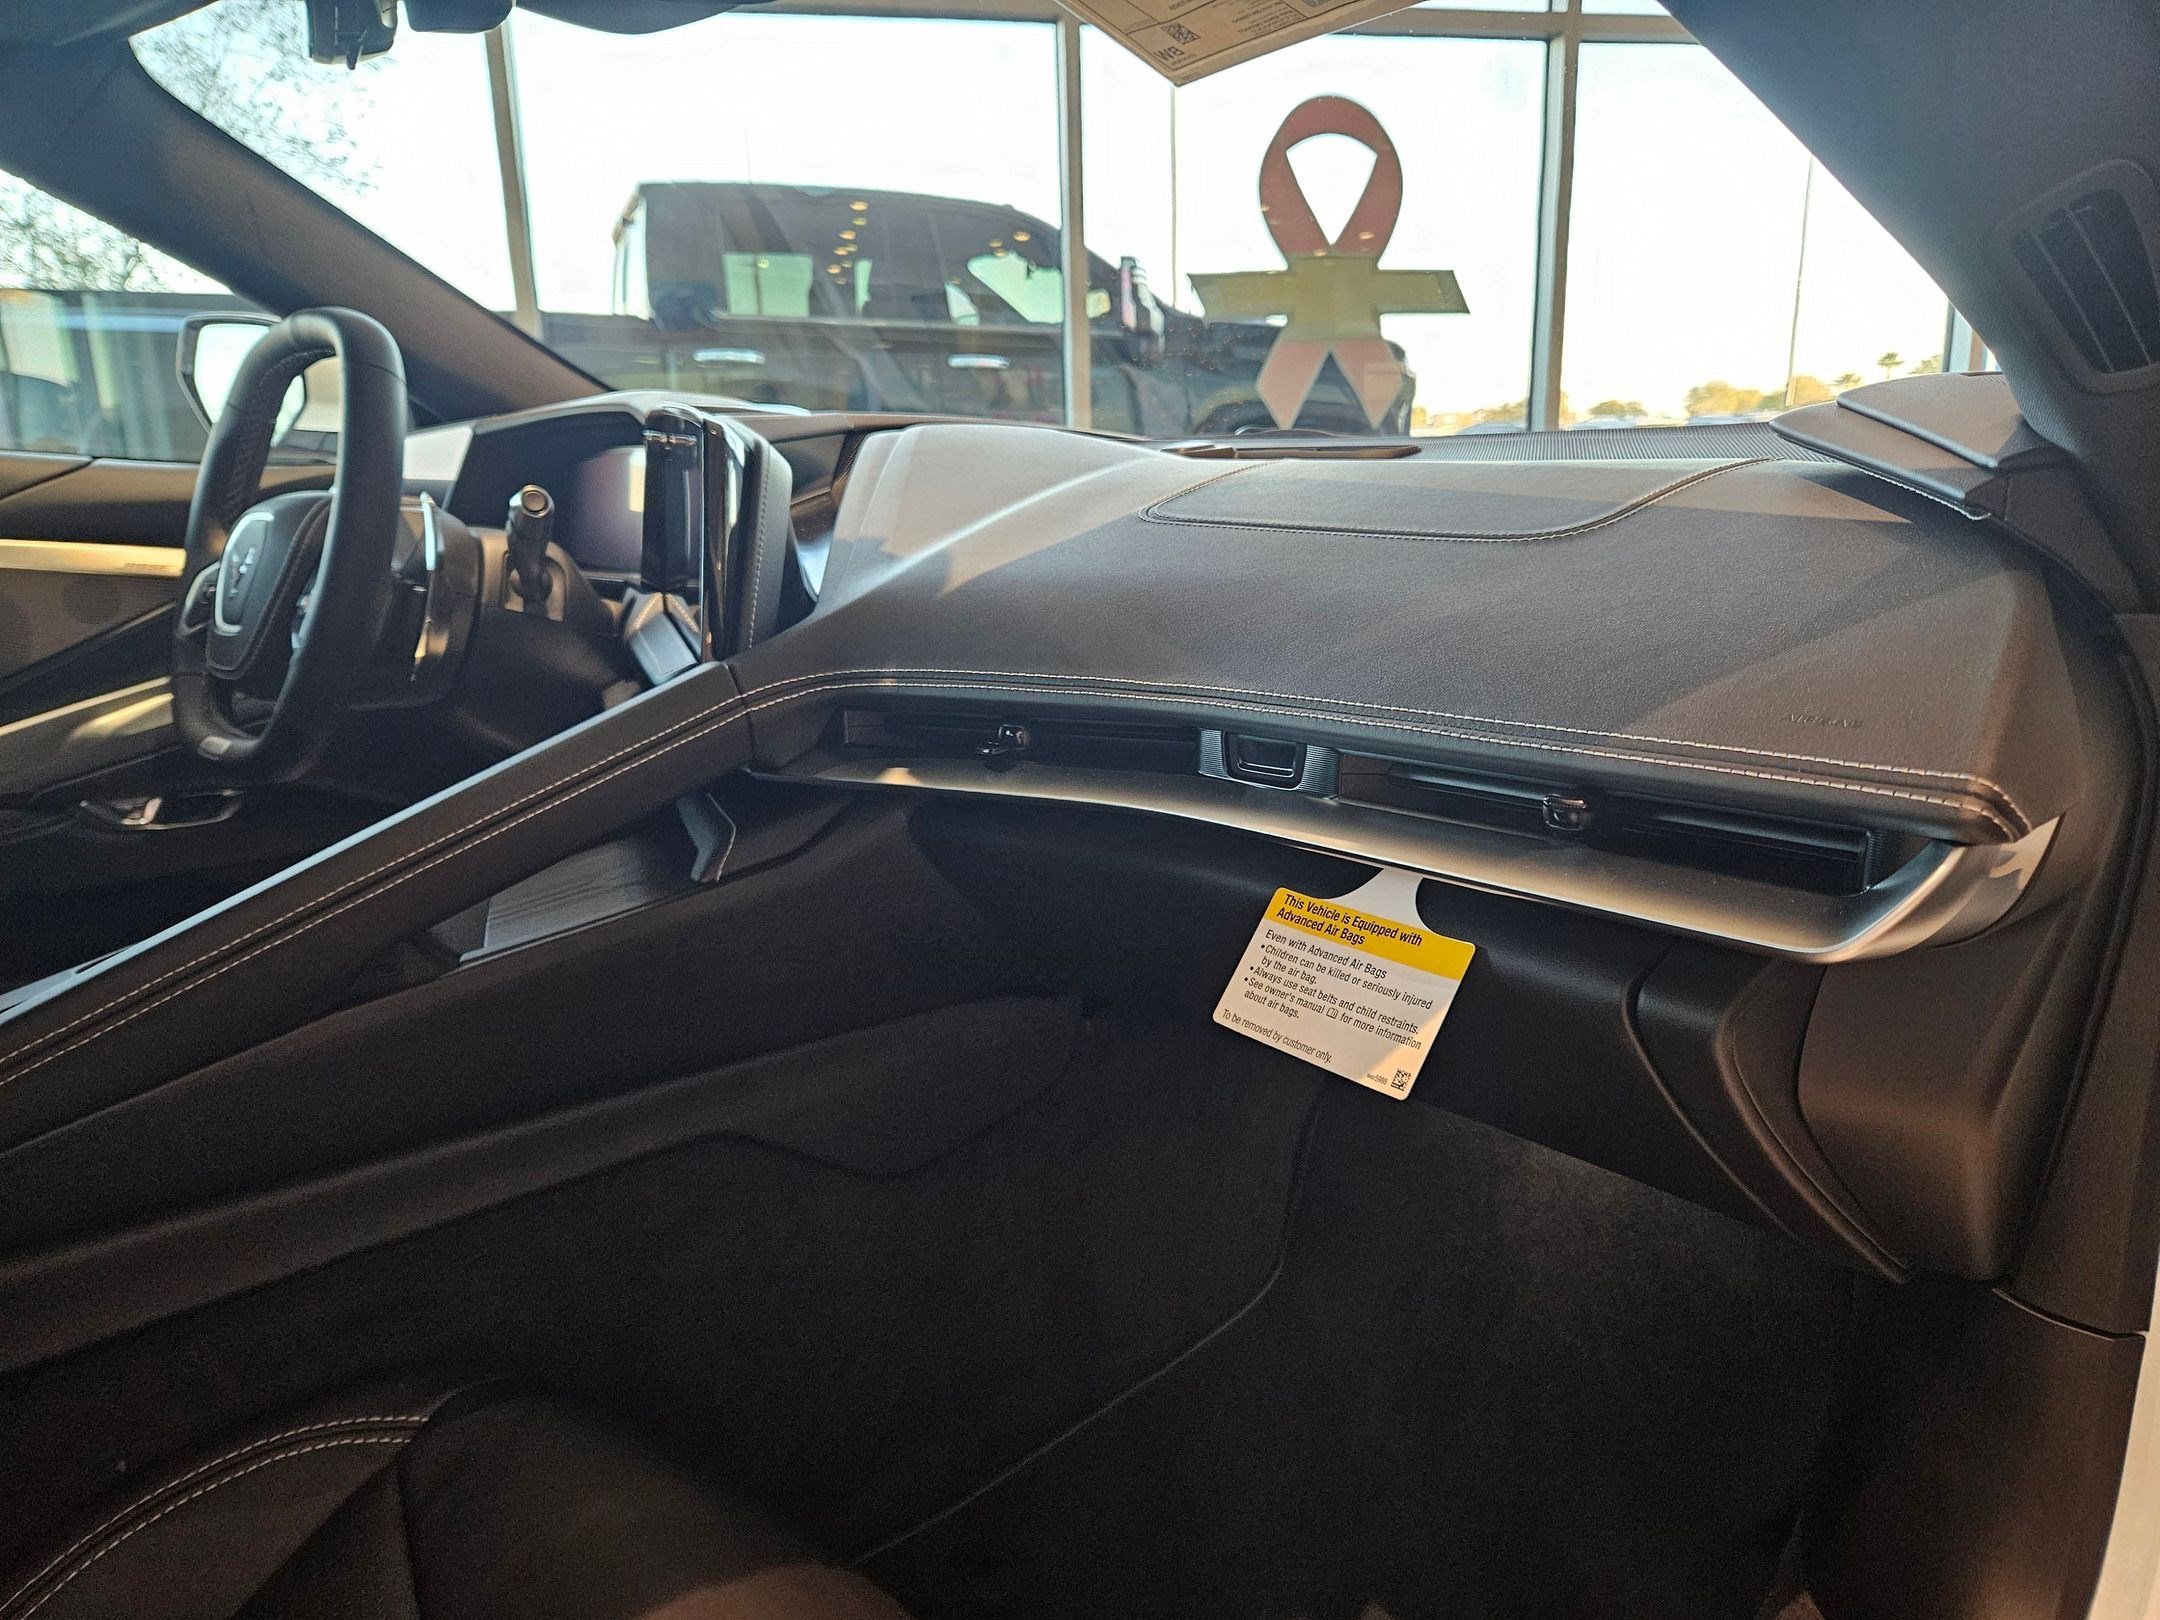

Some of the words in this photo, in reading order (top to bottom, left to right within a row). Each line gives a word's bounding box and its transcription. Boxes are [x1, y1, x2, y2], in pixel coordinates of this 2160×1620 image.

[1276, 907, 1325, 931] Advanced
[1323, 923, 1340, 936] Air
[1339, 927, 1365, 945] Bags
[1284, 893, 1304, 909] This
[1306, 901, 1340, 921] Vehicle
[1340, 912, 1351, 924] is
[1351, 915, 1399, 939] Equipped
[1399, 932, 1422, 946] with
[1261, 955, 1272, 968] by
[1273, 960, 1287, 972] the
[1287, 967, 1300, 977] air
[1300, 970, 1316, 984] bag.
[1265, 929, 1287, 944] Even
[1288, 939, 1307, 951] with
[1307, 944, 1350, 966] Advanced
[1349, 958, 1363, 970] Air
[1364, 963, 1387, 979] Bags
[1265, 944, 1298, 963] Children
[1299, 958, 1315, 969] can
[1315, 962, 1326, 973] be
[1327, 966, 1351, 982] killed
[1351, 976, 1361, 985] or
[1361, 980, 1401, 1000] seriously
[1401, 991, 1433, 1009] injured
[1244, 990, 1267, 1005] about
[1267, 999, 1279, 1009] air
[1279, 1002, 1299, 1018] bags.
[1248, 977, 1263, 990] See
[1264, 985, 1295, 1002] owner's
[1295, 997, 1326, 1014] manual
[1339, 1012, 1353, 1024] for
[1352, 1019, 1374, 1032] more
[1375, 1025, 1421, 1049] information
[1253, 966, 1282, 984] Always
[1283, 979, 1298, 990] use
[1298, 985, 1317, 997] seat
[1317, 990, 1338, 1005] belts
[1338, 999, 1356, 1011] and
[1355, 1005, 1378, 1019] child
[1377, 1014, 1418, 1034] restraints.
[1222, 1008, 1231, 1020] To
[1231, 1013, 1241, 1024] be
[1241, 1019, 1273, 1038] removed
[1272, 1030, 1283, 1043] by
[1282, 1036, 1315, 1056] customer
[1316, 1050, 1332, 1063] only.
